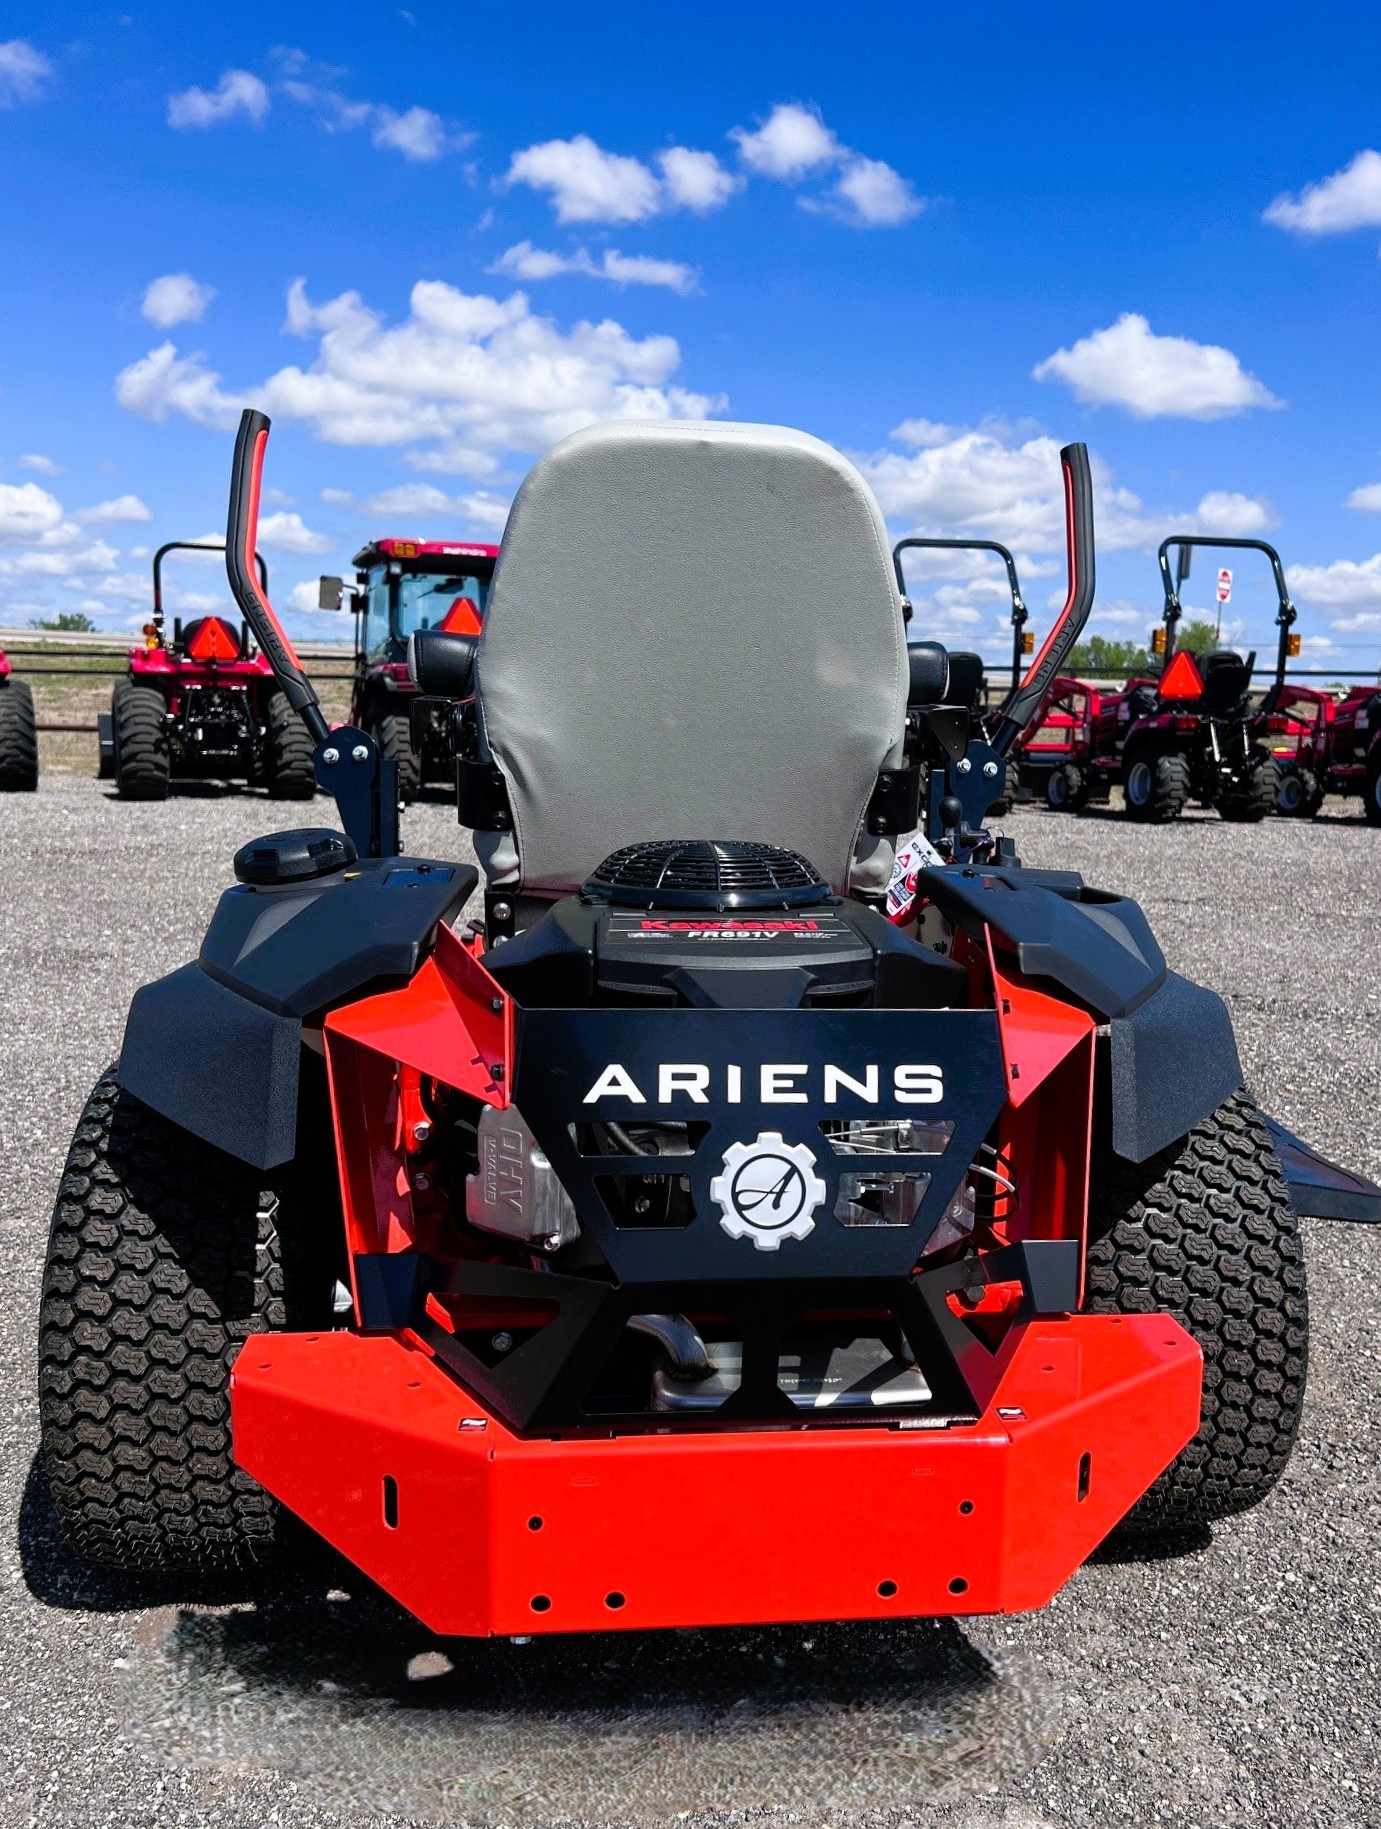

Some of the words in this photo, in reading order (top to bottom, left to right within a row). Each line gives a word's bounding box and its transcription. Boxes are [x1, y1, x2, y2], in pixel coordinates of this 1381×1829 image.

[640, 920, 819, 930] Kawasaki
[582, 1064, 944, 1103] ARIENS
[499, 1127, 522, 1214] OHV
